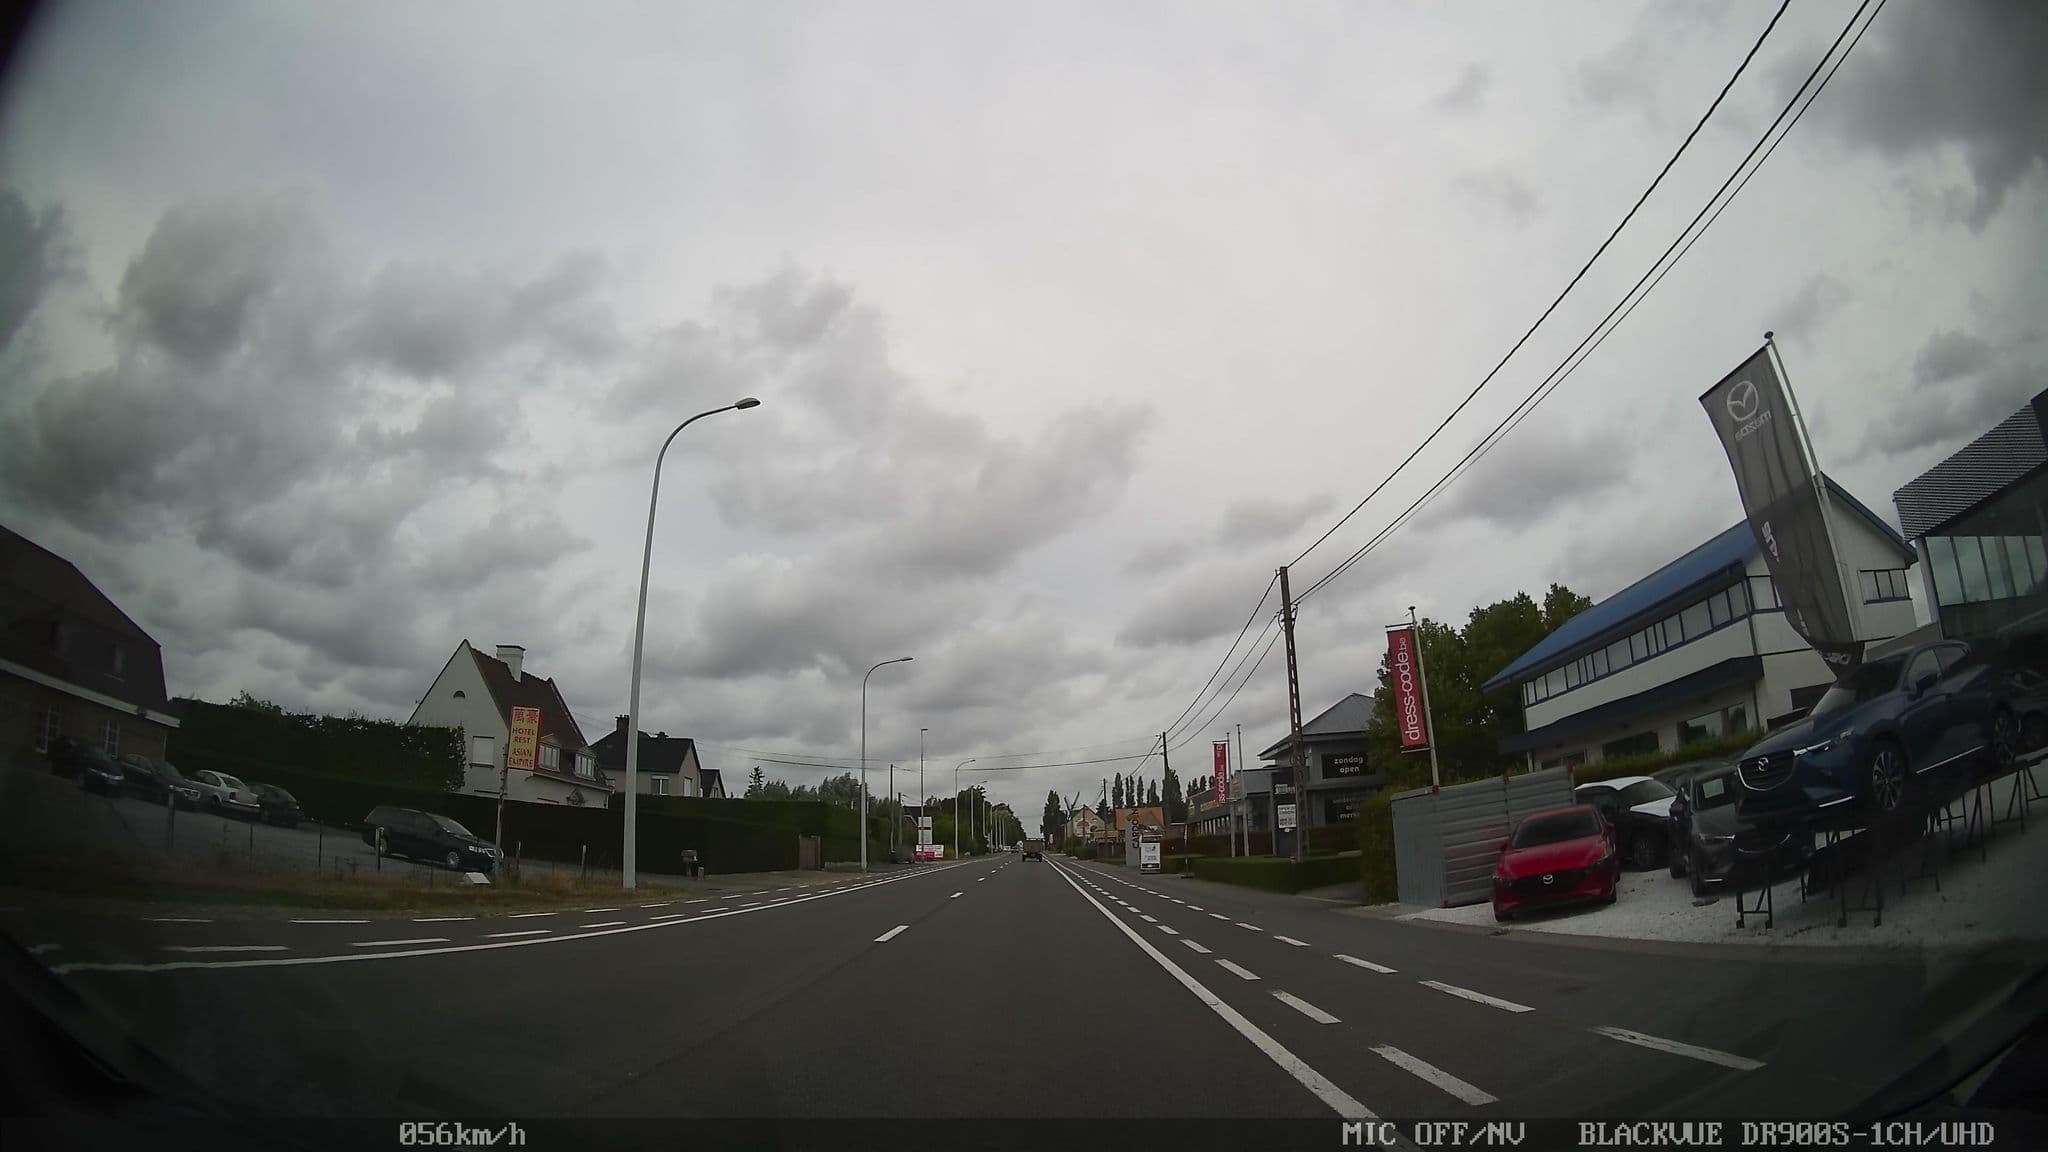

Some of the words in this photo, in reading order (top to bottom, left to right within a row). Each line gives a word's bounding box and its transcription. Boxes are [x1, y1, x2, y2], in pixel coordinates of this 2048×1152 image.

[1394, 637, 1421, 741] dress-code.be
[512, 727, 536, 736] HOTEL
[511, 748, 532, 758] ASIAN
[508, 757, 534, 768] EMPIRE
[1334, 755, 1364, 765] zondag
[1339, 765, 1360, 775] open
